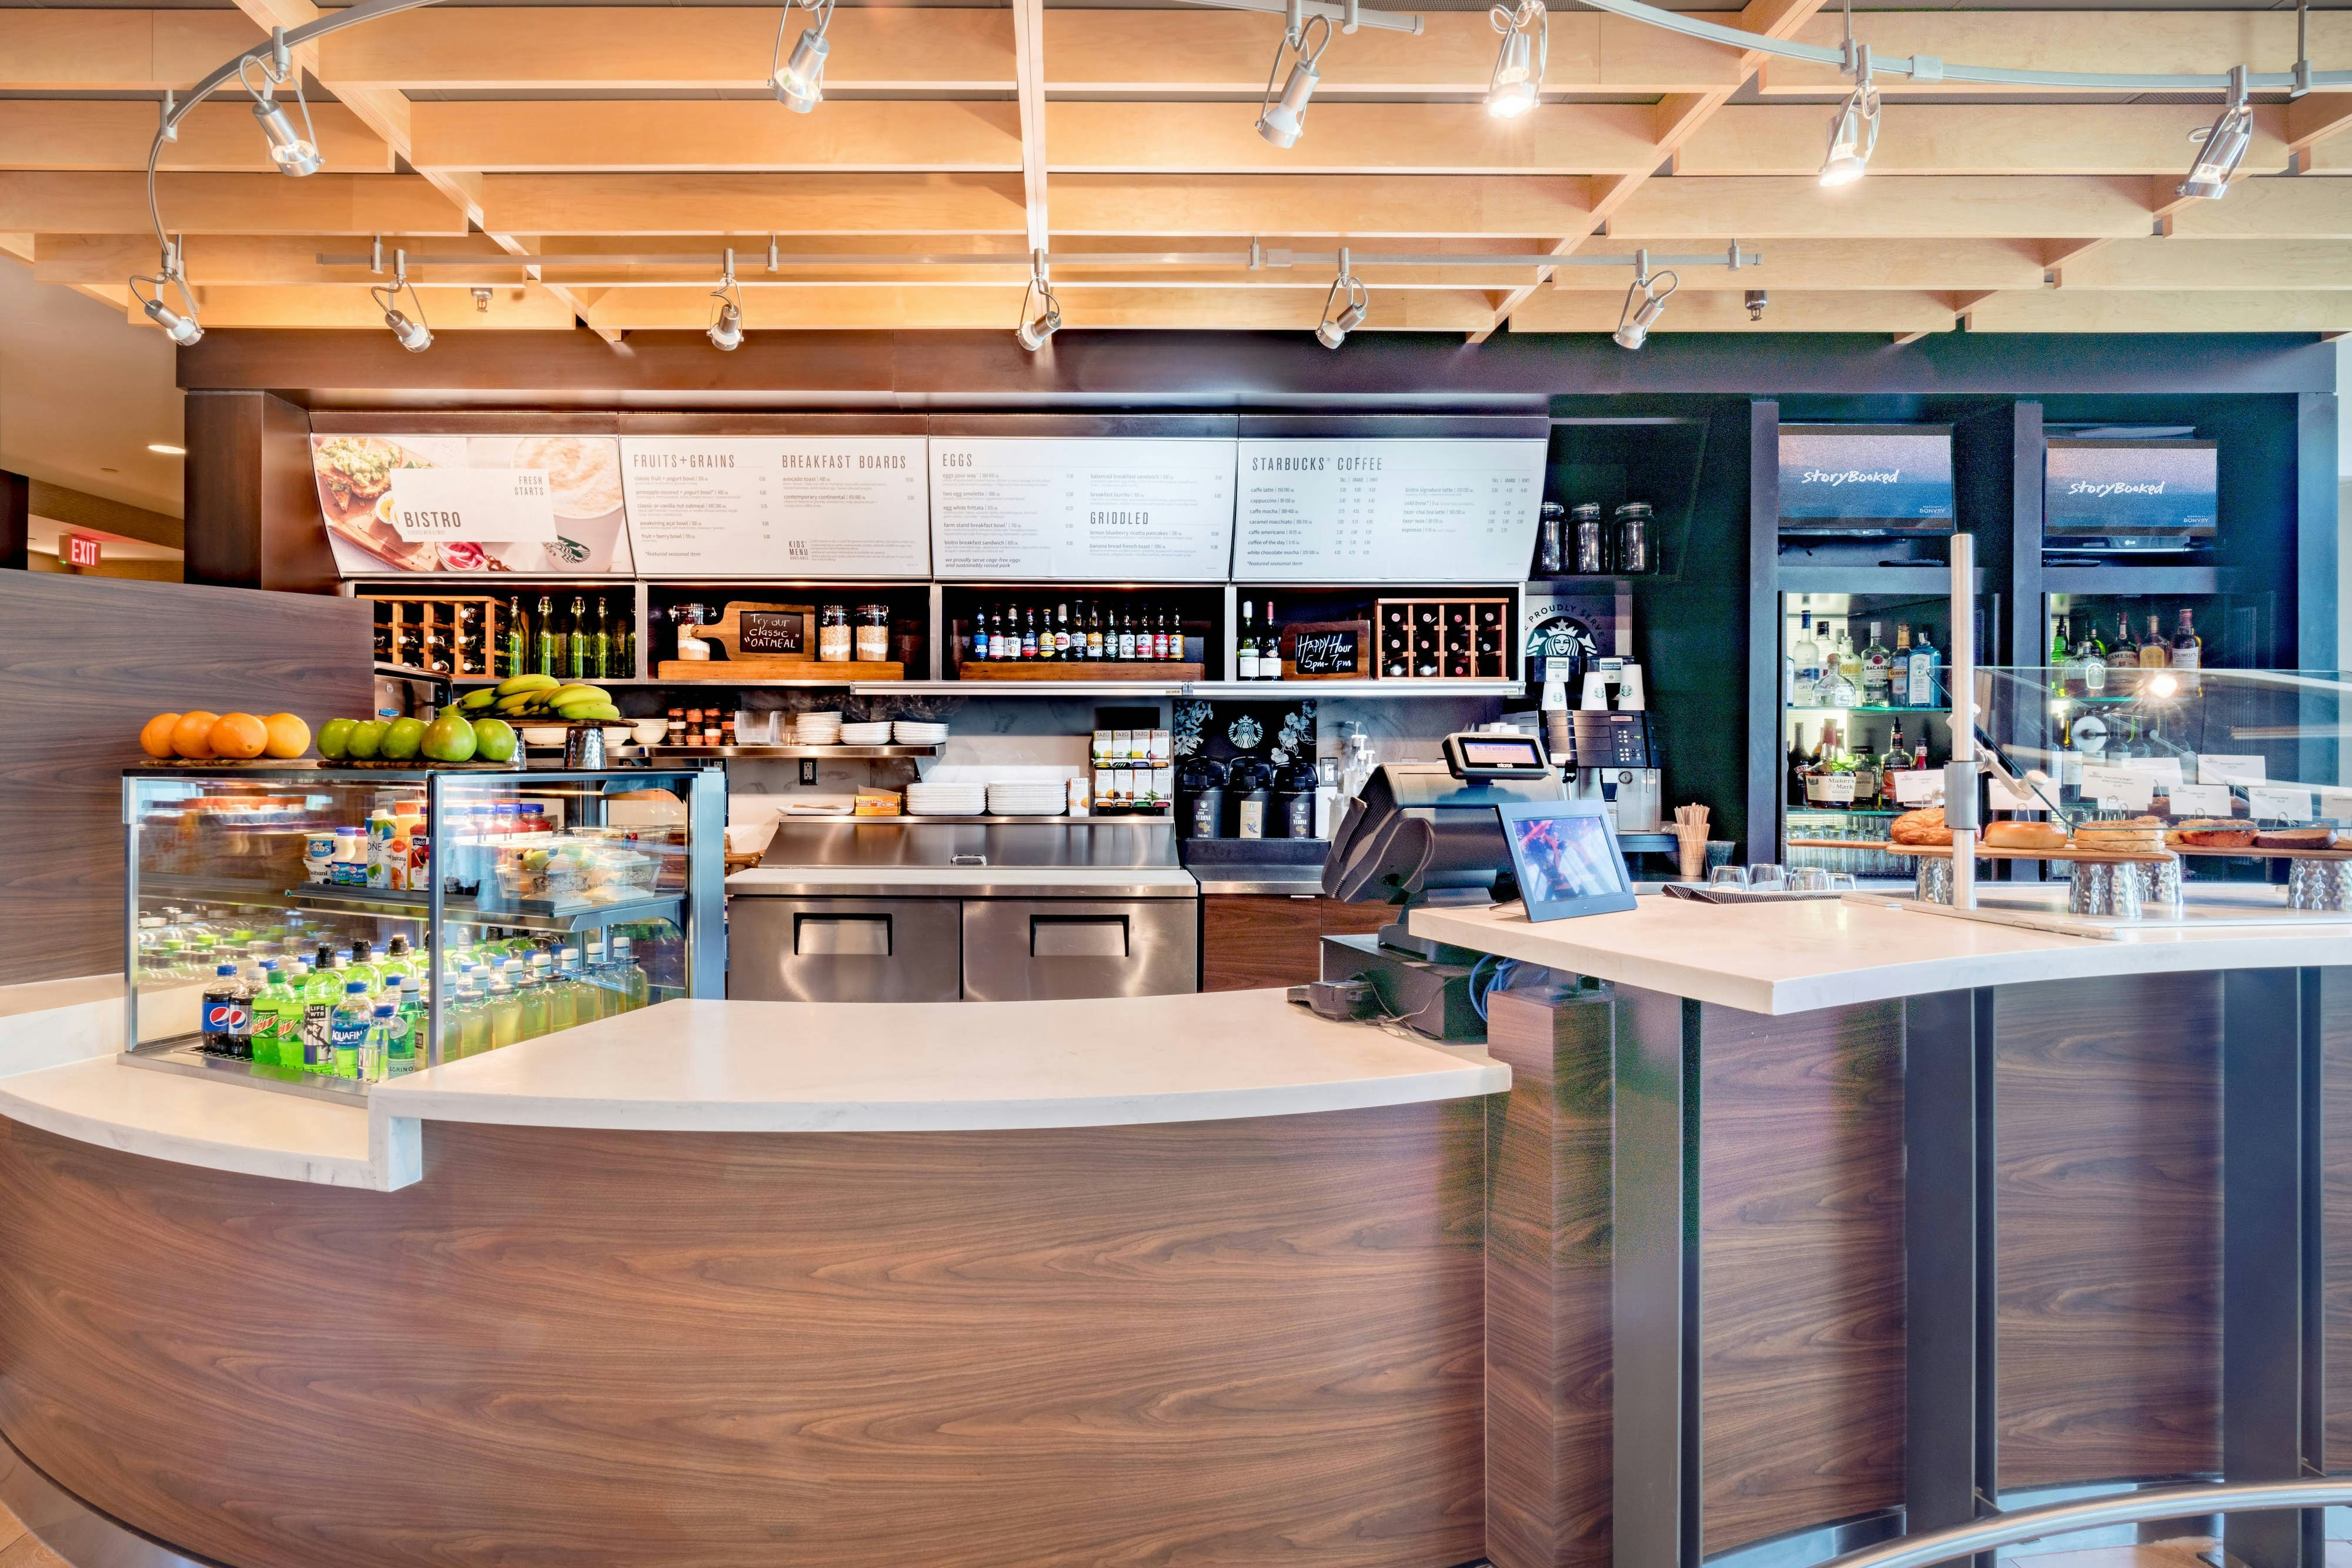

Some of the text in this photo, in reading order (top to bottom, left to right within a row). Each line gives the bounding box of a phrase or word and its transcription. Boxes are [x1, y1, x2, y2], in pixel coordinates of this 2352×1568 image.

[782, 455, 906, 469] BREAKFAST BOARDS
[943, 454, 972, 466] EGGS
[1252, 457, 1382, 470] STARBUCKS COFFEE
[519, 476, 542, 484] FRESH
[514, 487, 544, 496] STARTS
[404, 512, 461, 527] BISTRO
[1091, 511, 1148, 524] GRIDDLED
[72, 539, 96, 566] EXIT
[750, 614, 768, 629] Try
[1529, 604, 1605, 637] PROUDLY SERVE
[749, 627, 789, 637] classic
[1328, 634, 1352, 654] Hour
[332, 1030, 362, 1041] AQUAFIN
